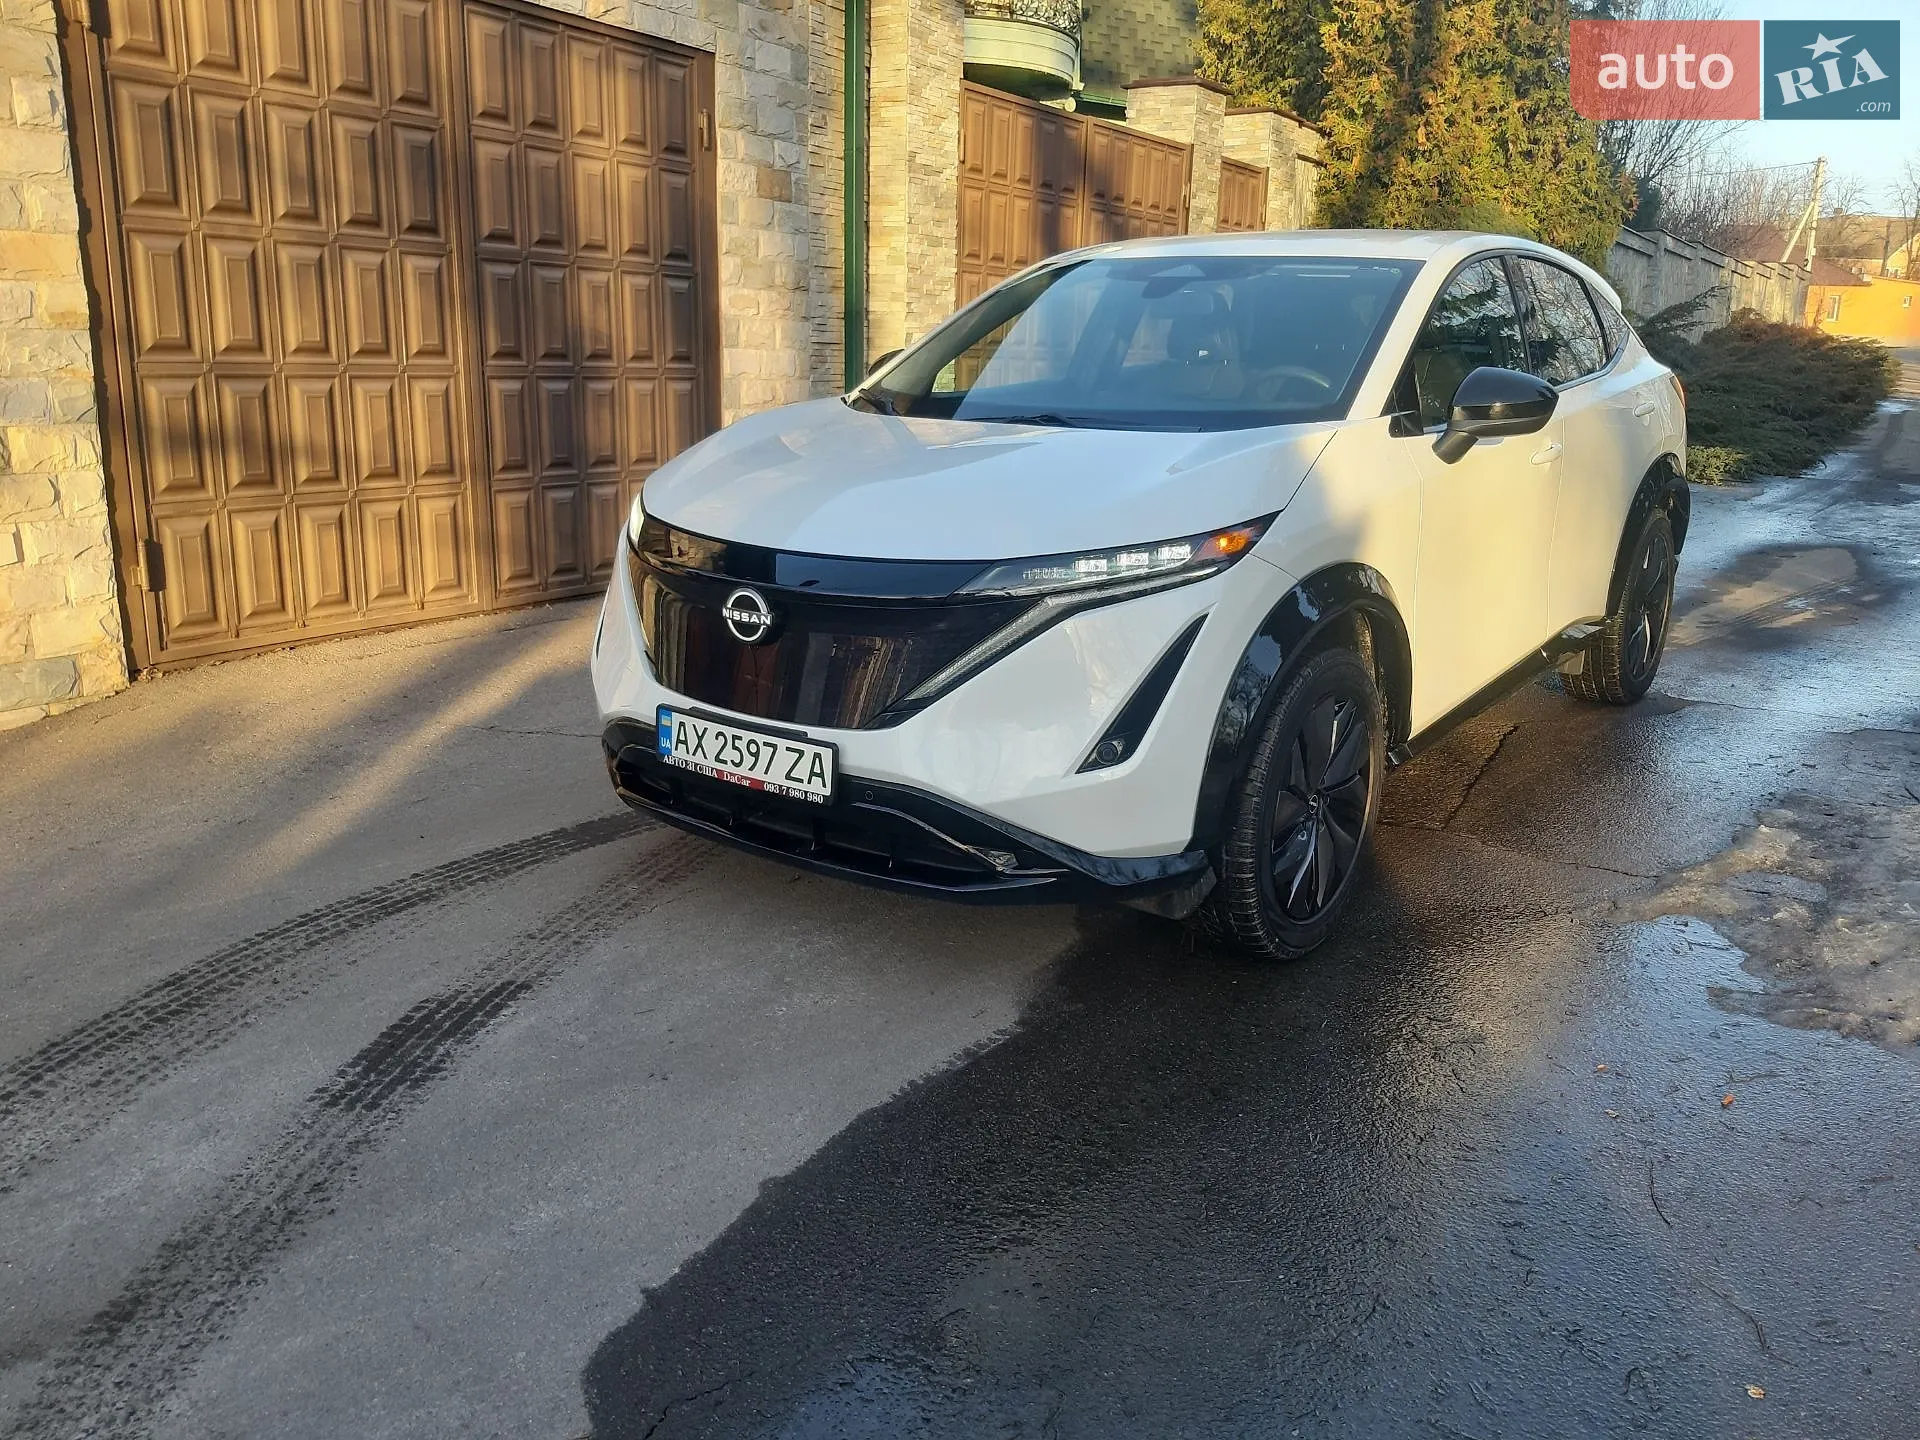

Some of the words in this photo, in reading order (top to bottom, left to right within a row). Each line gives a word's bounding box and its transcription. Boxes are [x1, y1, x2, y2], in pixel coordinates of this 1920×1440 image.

[722, 607, 771, 625] NISSAN
[660, 737, 672, 749] UA
[674, 721, 709, 760] AX
[714, 731, 779, 775] 2597
[784, 746, 828, 788] ZA
[663, 754, 686, 768] АВТО
[697, 764, 718, 778] США
[723, 771, 751, 787] DaCar
[763, 782, 780, 794] 093
[781, 786, 787, 796] 7
[788, 788, 805, 800] 980
[807, 792, 824, 804] 980
